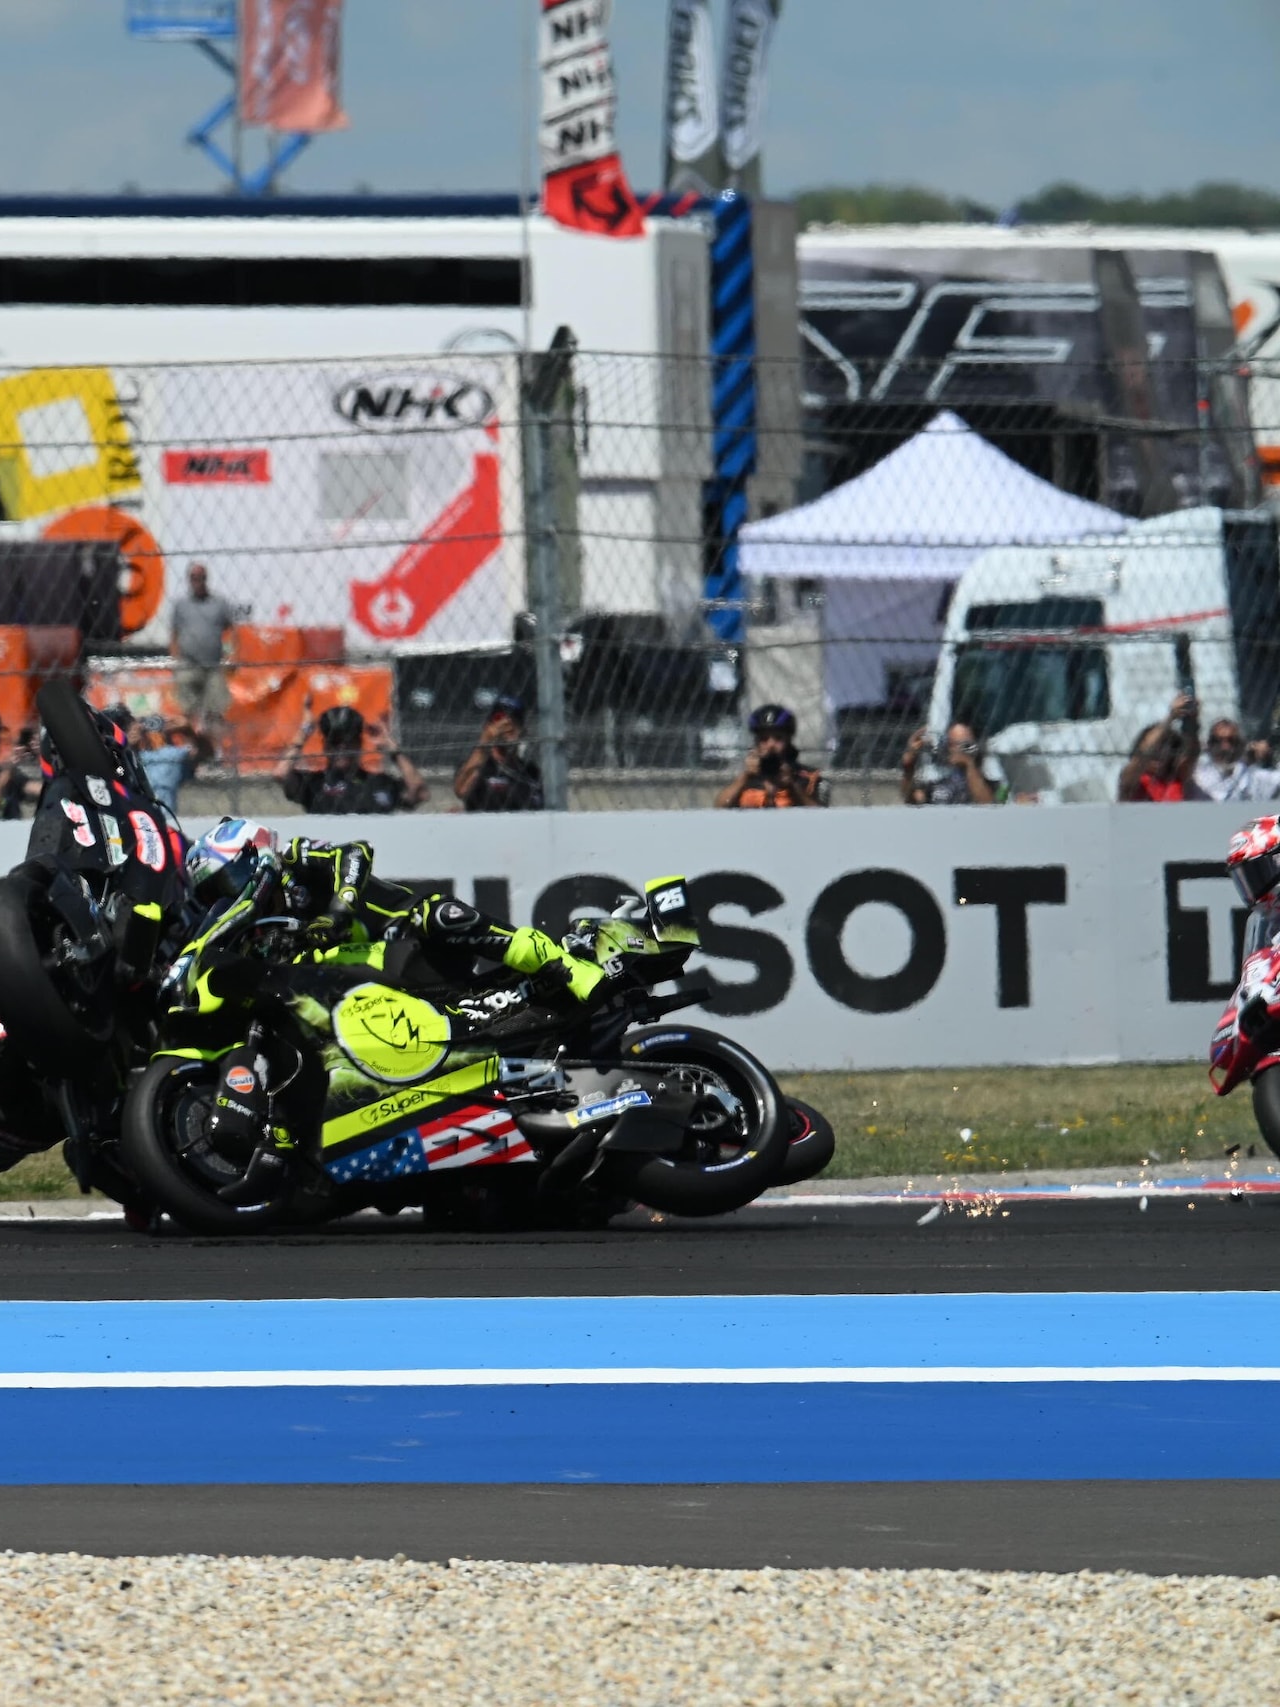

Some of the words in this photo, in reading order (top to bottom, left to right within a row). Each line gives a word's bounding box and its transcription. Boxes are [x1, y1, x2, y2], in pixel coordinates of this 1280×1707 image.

[347, 380, 480, 424] NHK
[654, 886, 686, 913] 25
[360, 866, 1067, 1016] SSOT
